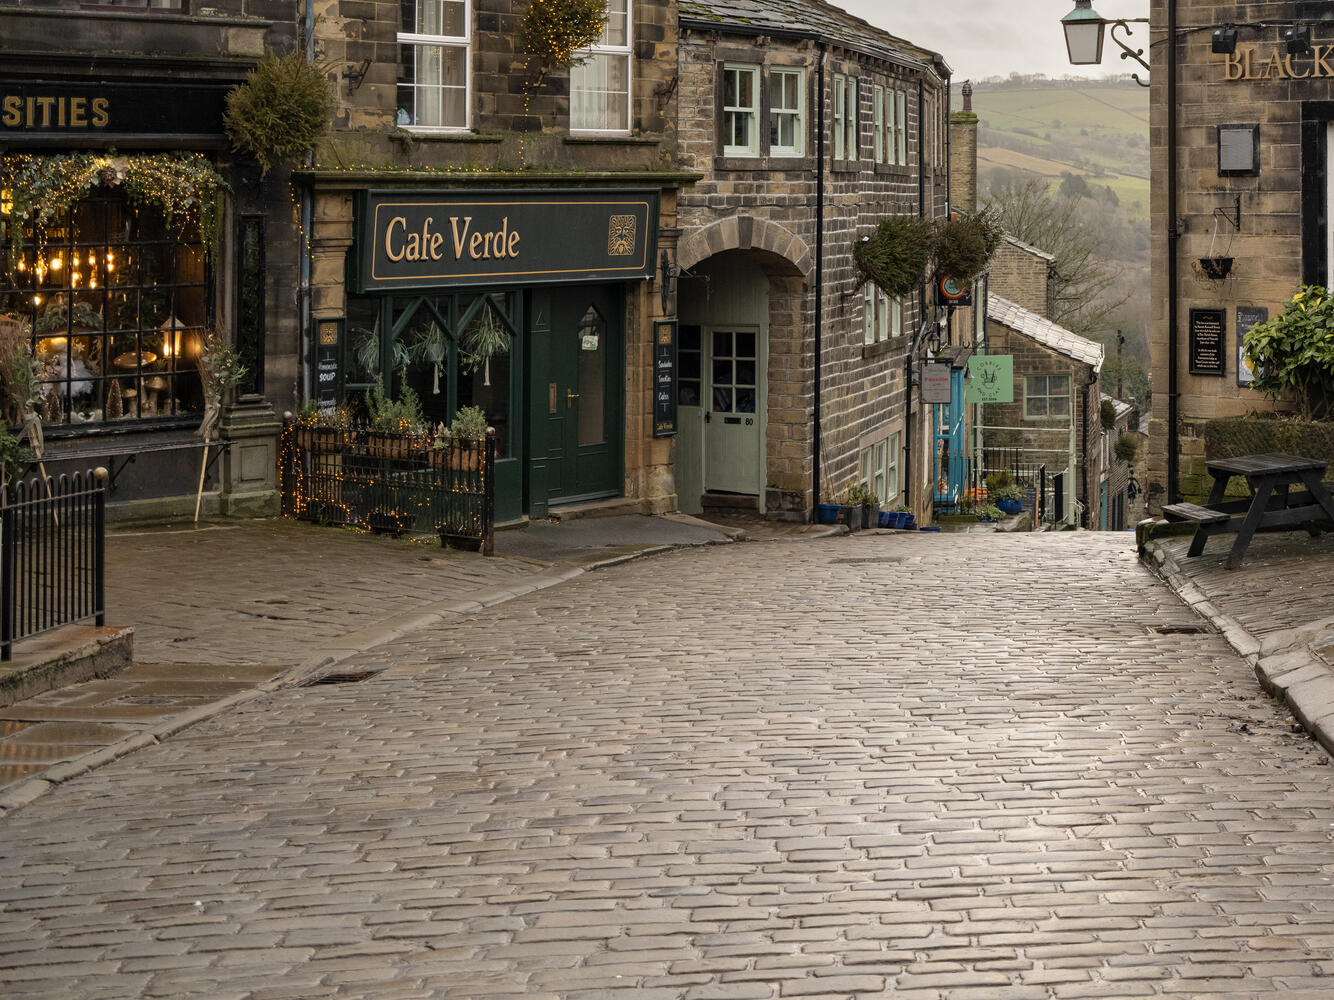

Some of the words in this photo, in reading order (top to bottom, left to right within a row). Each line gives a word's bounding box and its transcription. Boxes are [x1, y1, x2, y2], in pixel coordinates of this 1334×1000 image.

[3, 95, 110, 128] SITIES
[384, 216, 444, 262] Cafe
[449, 216, 521, 260] Verde
[319, 372, 336, 382] SOUP
[745, 417, 754, 426] 80
